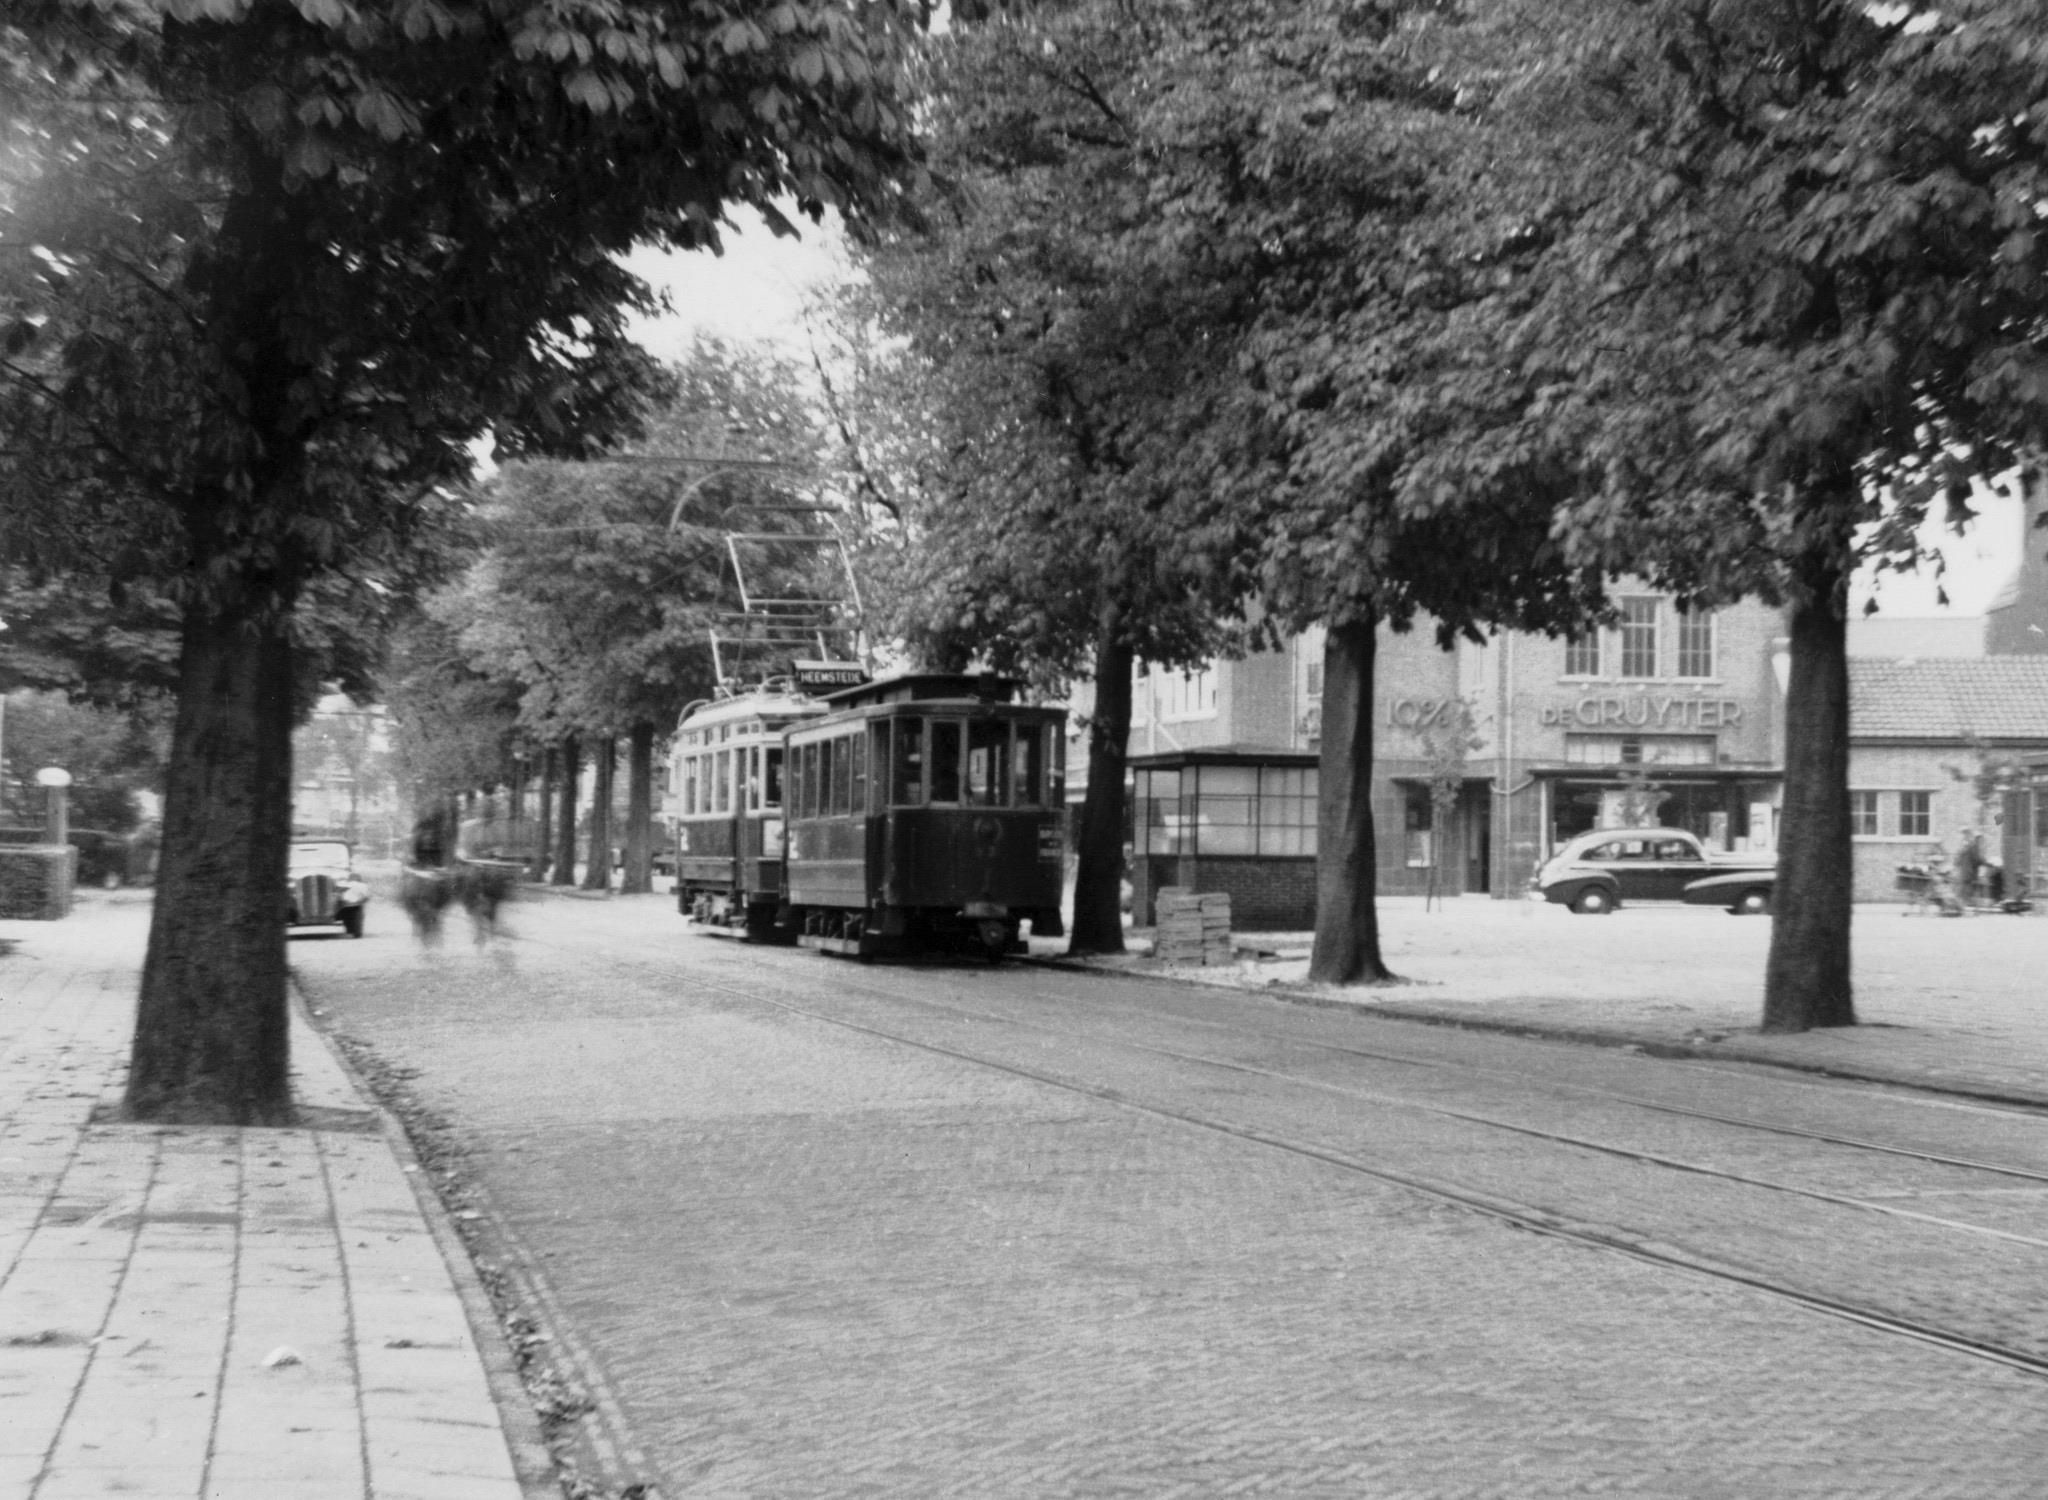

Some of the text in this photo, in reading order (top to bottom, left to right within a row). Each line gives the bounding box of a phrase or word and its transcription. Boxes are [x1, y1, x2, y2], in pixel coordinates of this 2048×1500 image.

[800, 671, 862, 684] HEEMSTEDE
[1387, 698, 1450, 730] 10%
[1540, 697, 1743, 728] DE GRUYTER
